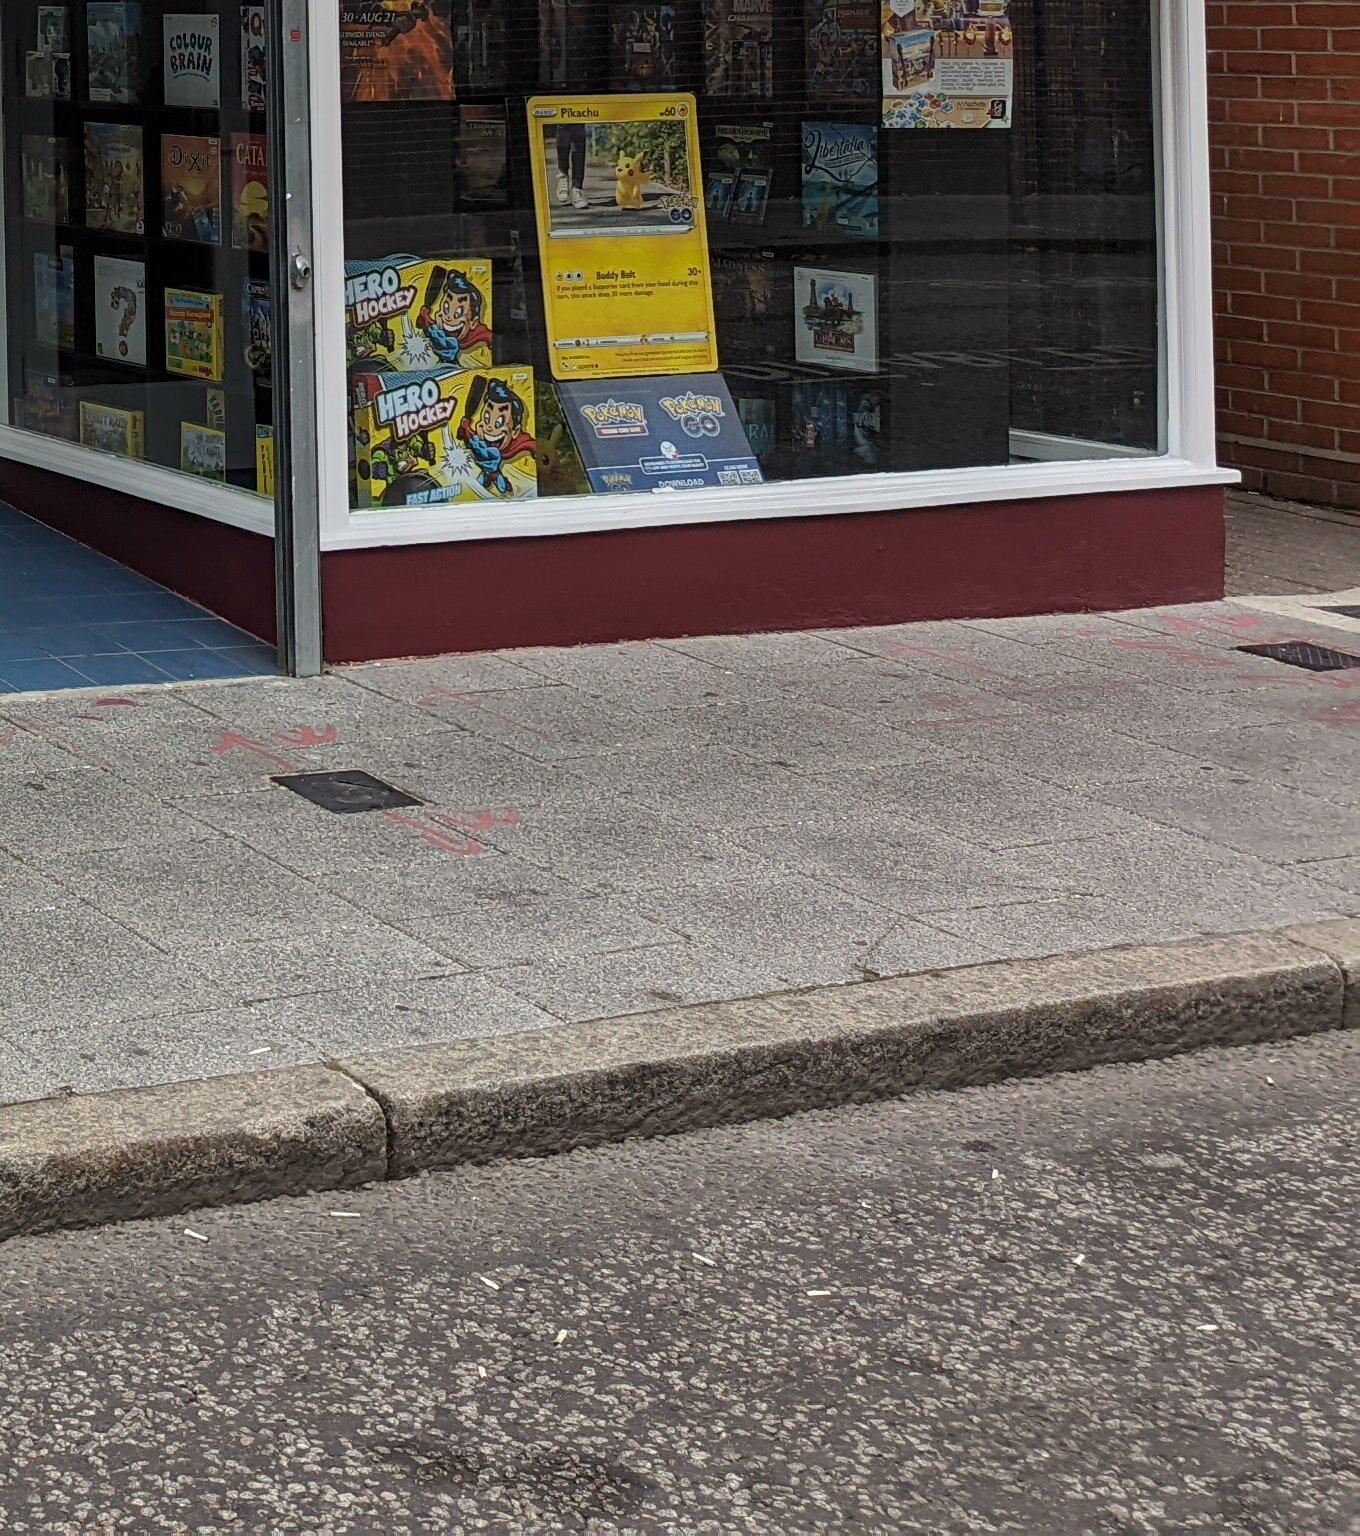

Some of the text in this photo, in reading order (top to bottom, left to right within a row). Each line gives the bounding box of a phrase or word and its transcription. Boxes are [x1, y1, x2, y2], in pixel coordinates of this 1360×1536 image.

[169, 32, 213, 55] COLOUR
[170, 52, 213, 75] BRAIN
[560, 106, 599, 118] Pikachu
[356, 287, 415, 322] HOCKEY
[377, 379, 439, 422] HERO
[395, 400, 456, 438] HOCKEY
[406, 483, 461, 505] FAST ACTION
[658, 478, 705, 488] DOWNLOAD
